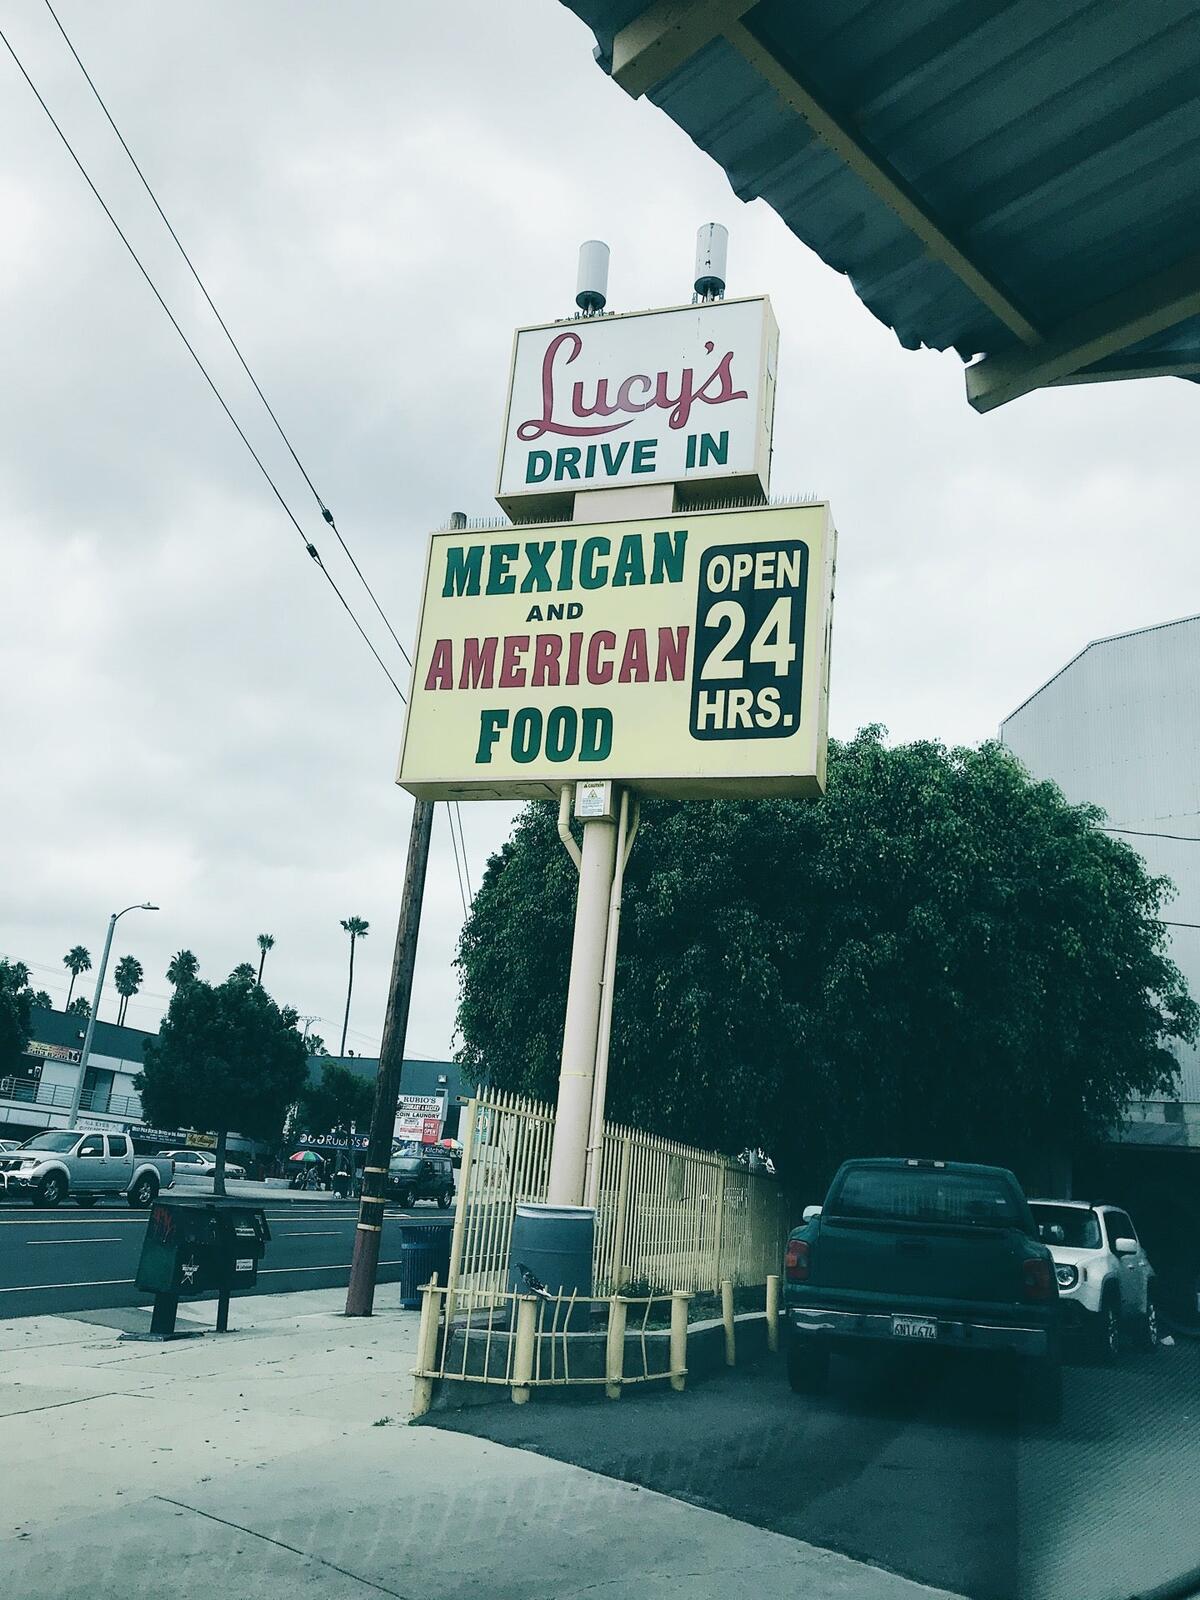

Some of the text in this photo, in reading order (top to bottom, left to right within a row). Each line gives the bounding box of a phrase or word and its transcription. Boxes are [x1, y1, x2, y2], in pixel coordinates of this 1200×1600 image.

[517, 332, 748, 441] Lucy's
[526, 431, 729, 484] DRIVE IN
[442, 531, 688, 597] MEXICAN
[706, 549, 802, 593] OPEN
[526, 603, 583, 622] AND
[701, 597, 796, 680] 24
[424, 626, 690, 691] AMERICAN
[475, 706, 613, 764] FOOD
[696, 687, 793, 730] HRS.
[403, 1096, 436, 1104] RUBIO'S
[424, 1128, 438, 1136] OPEN
